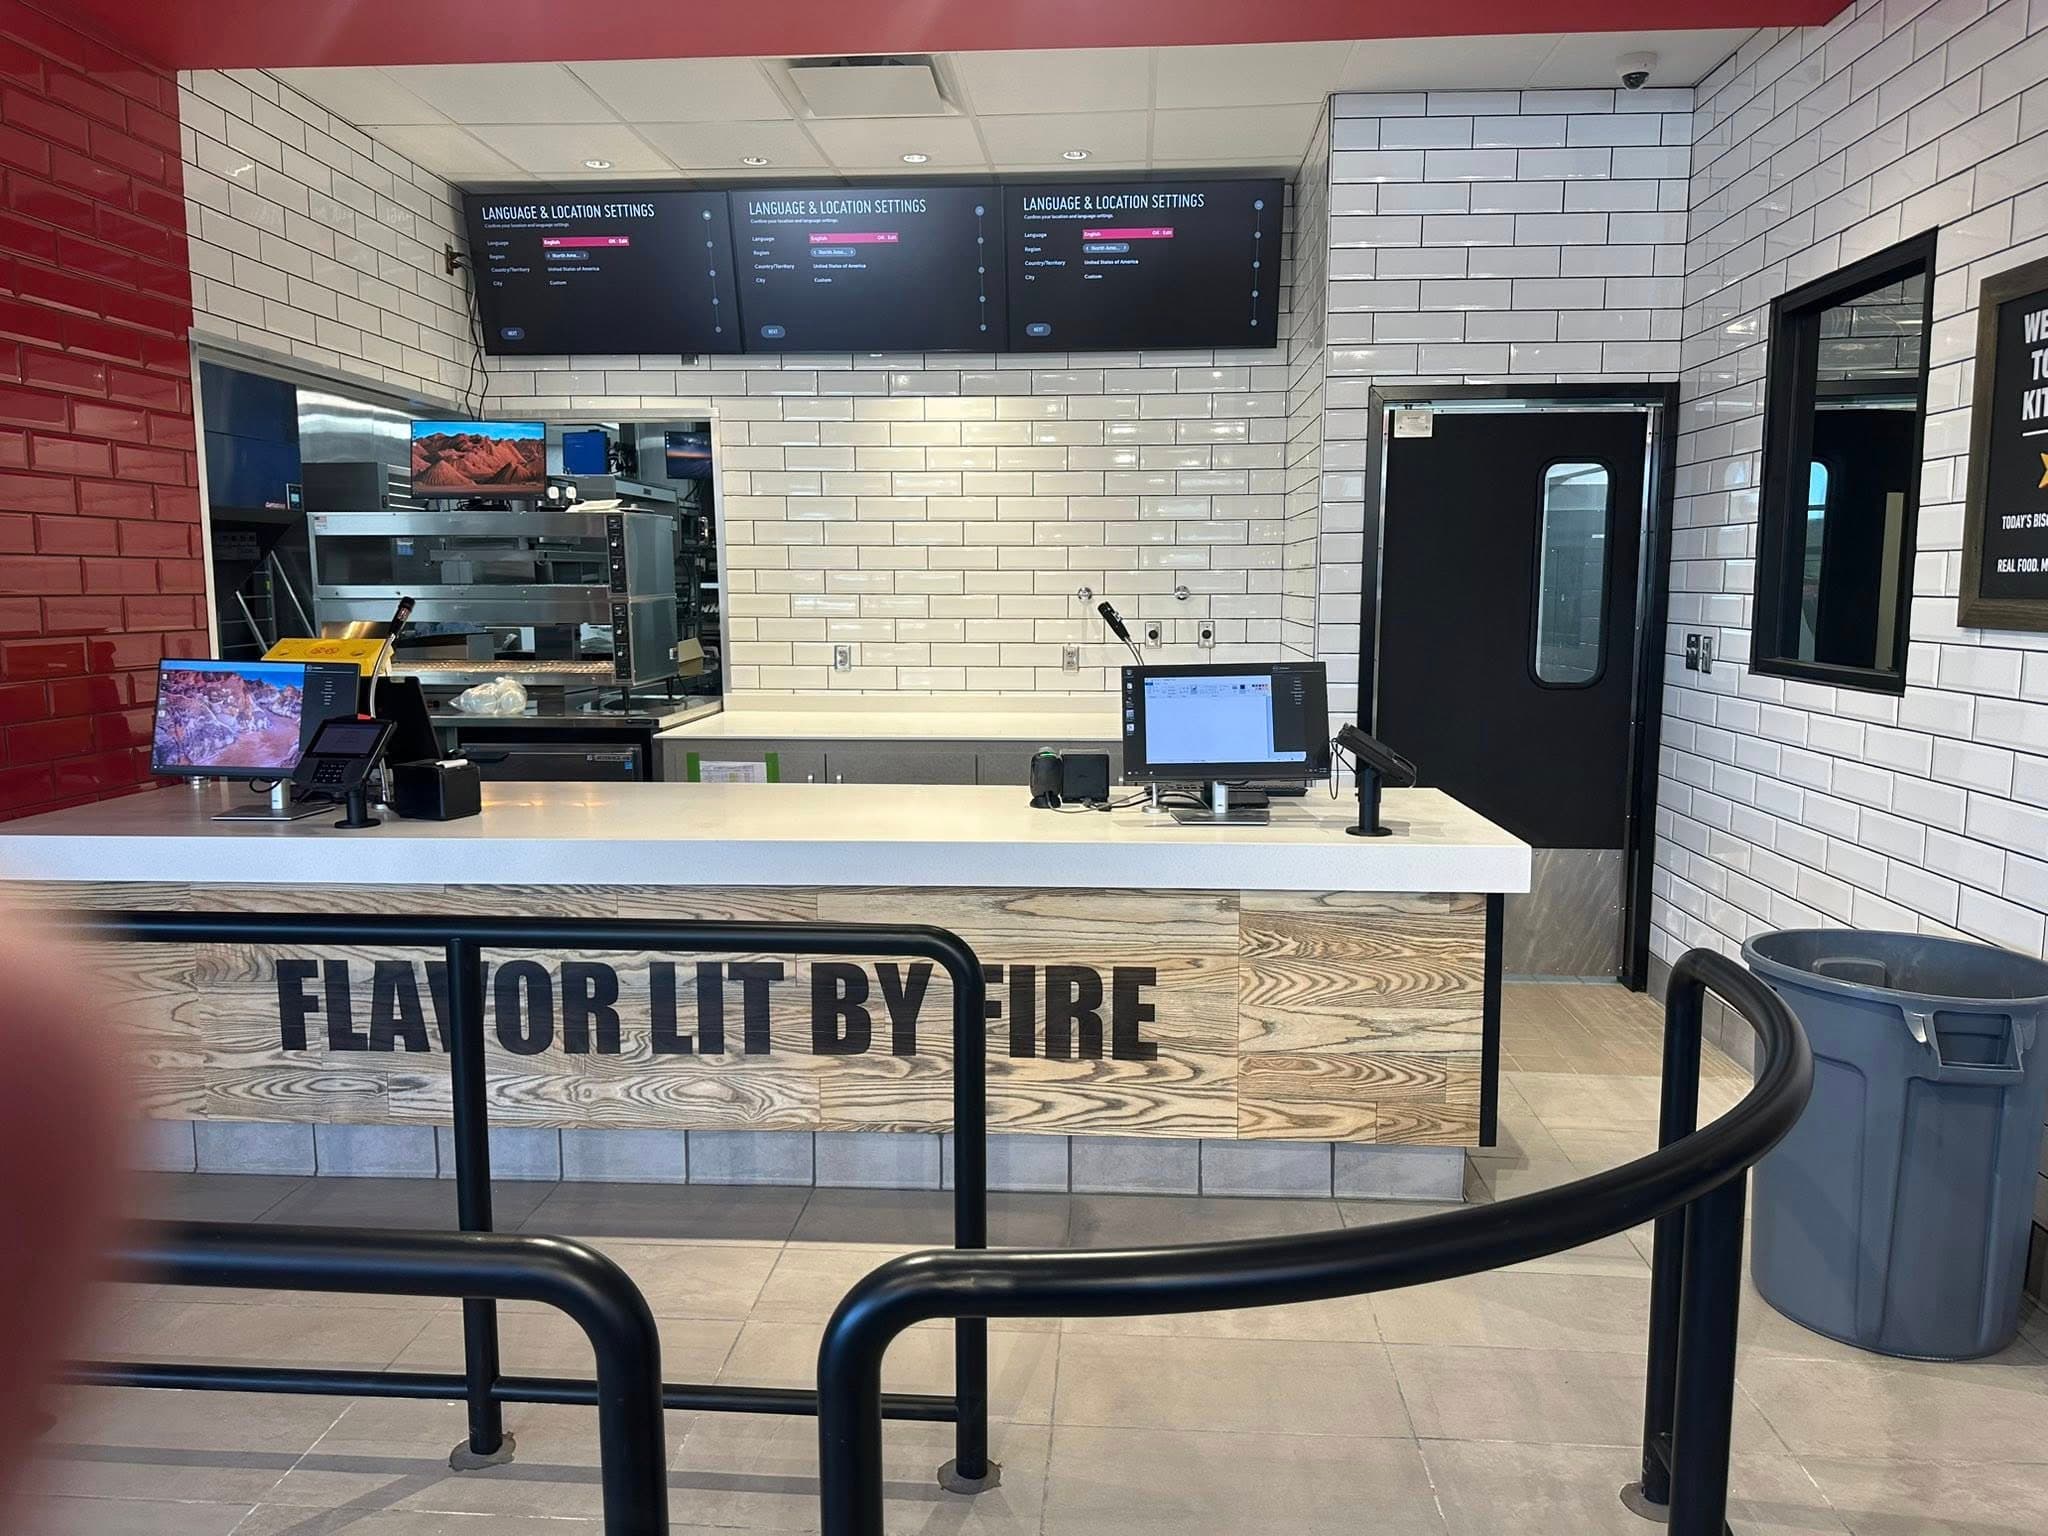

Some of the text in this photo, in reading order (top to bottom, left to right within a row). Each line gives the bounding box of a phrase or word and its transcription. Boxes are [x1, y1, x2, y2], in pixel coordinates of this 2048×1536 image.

[749, 199, 927, 215] LANGUAGE & LOCATION SETTINGS
[1023, 193, 1205, 211] LANGUAGE & LOCATION SETTINGS
[482, 203, 655, 220] LANGUAGE & LOCATION SETTINGS
[1024, 259, 1066, 267] Country/Territory
[1024, 273, 1035, 281] City
[2024, 309, 2048, 343] WE
[2022, 386, 2048, 421] KIT
[2002, 512, 2048, 530] TODAY'S BIS
[1997, 558, 2016, 573] REAL
[2017, 558, 2039, 573] FOOD.
[649, 961, 784, 1055] LIT
[811, 962, 934, 1057] BY
[979, 963, 1158, 1061] IRE
